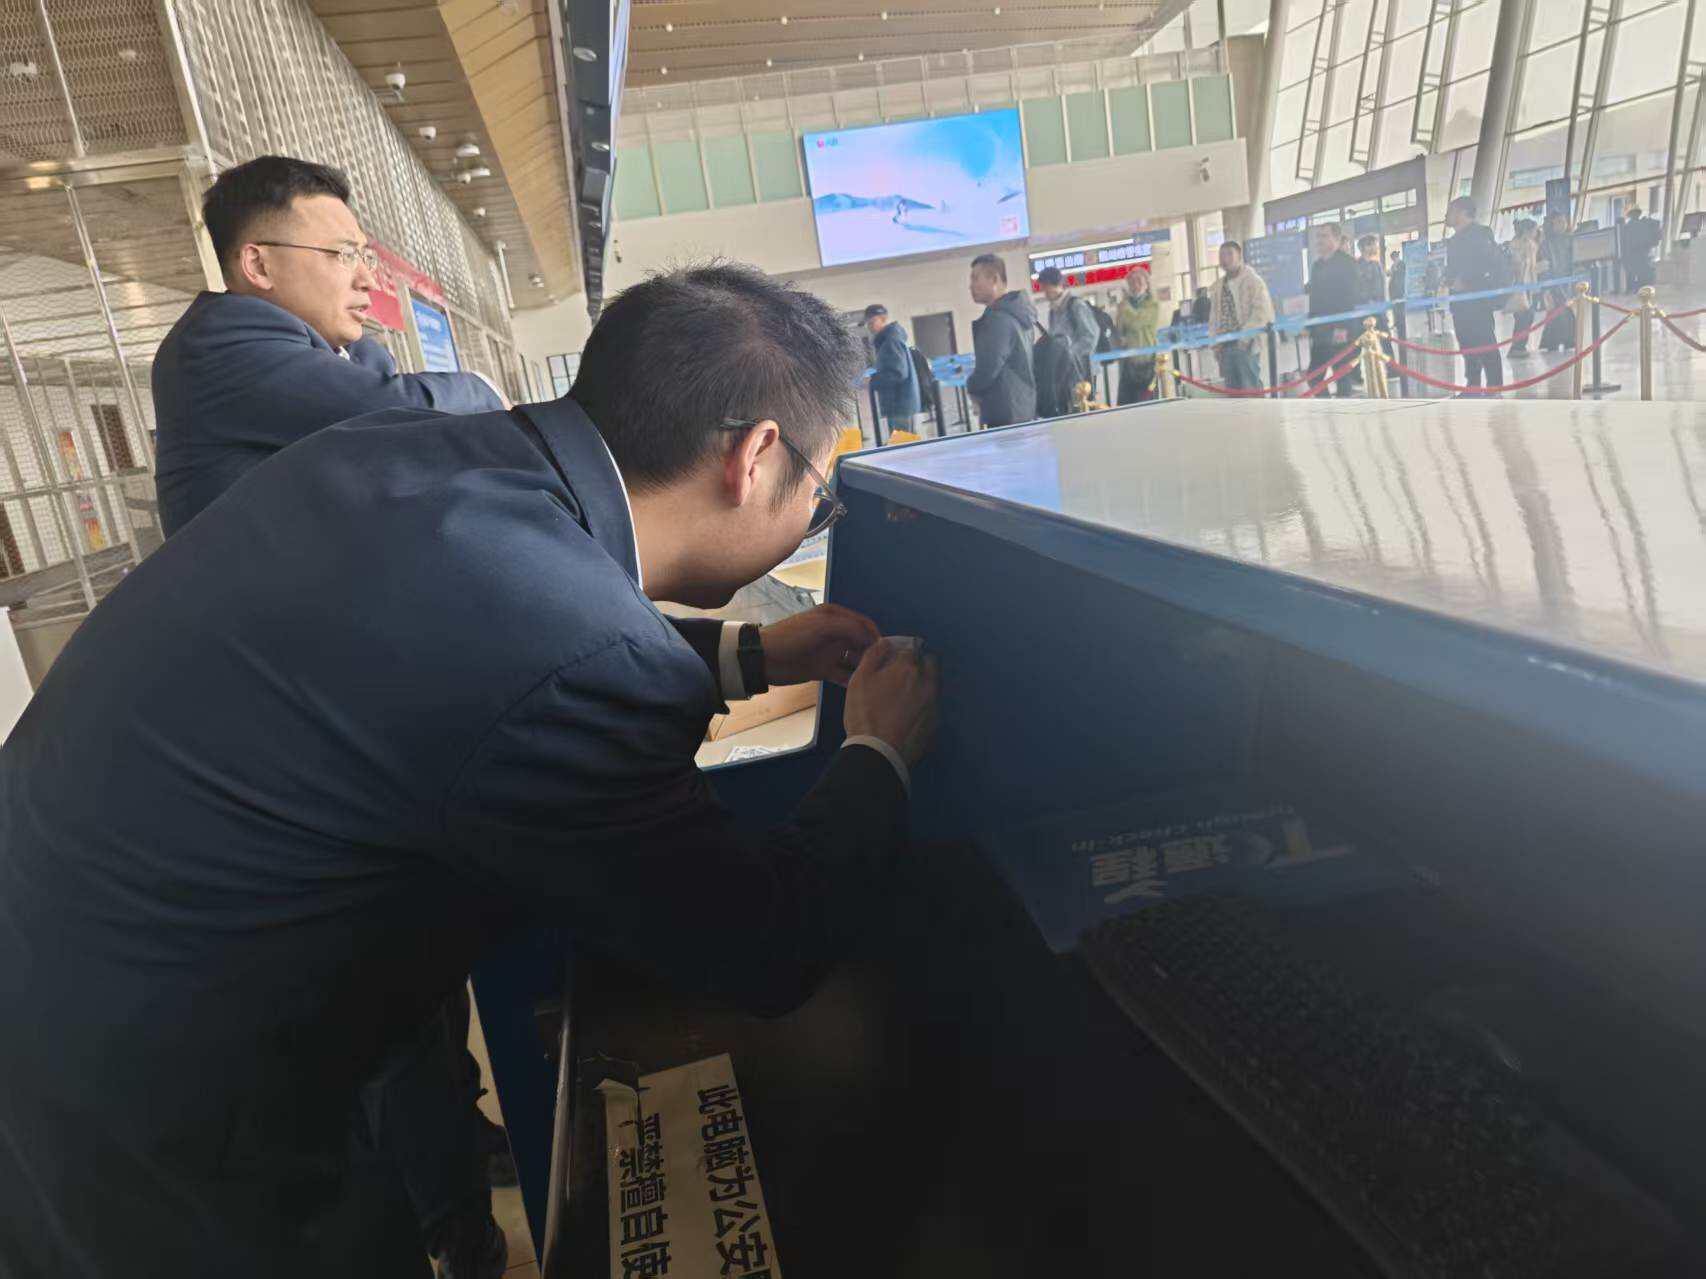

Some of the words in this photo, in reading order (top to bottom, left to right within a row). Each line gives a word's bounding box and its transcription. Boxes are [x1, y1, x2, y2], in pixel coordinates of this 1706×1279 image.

[697, 1084, 771, 1279] 此电脑为公安
